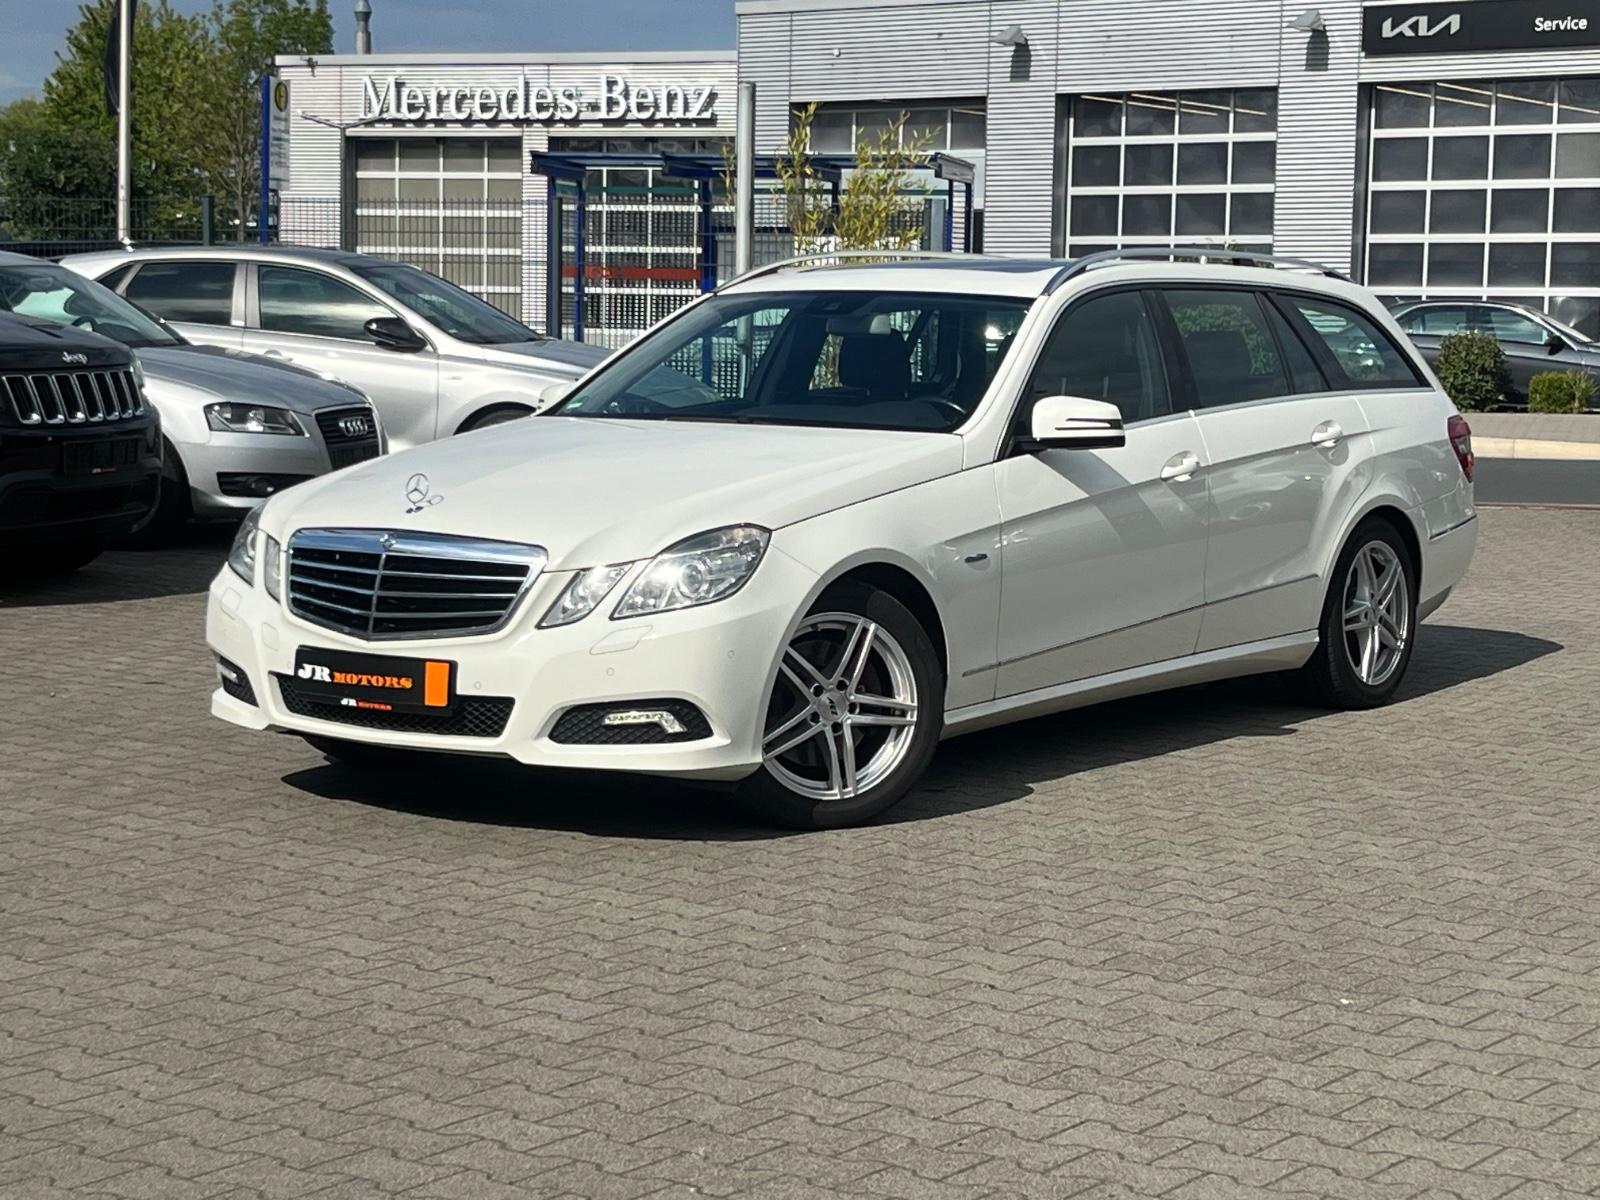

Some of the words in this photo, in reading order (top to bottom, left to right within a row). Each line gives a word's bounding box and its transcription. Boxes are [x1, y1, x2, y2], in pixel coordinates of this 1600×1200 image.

[1382, 14, 1461, 38] KIA
[1534, 16, 1588, 32] Service
[358, 73, 714, 121] Mercedes-Benz
[62, 351, 88, 364] Jeep
[298, 663, 332, 682] JR
[333, 671, 413, 689] MOTORS
